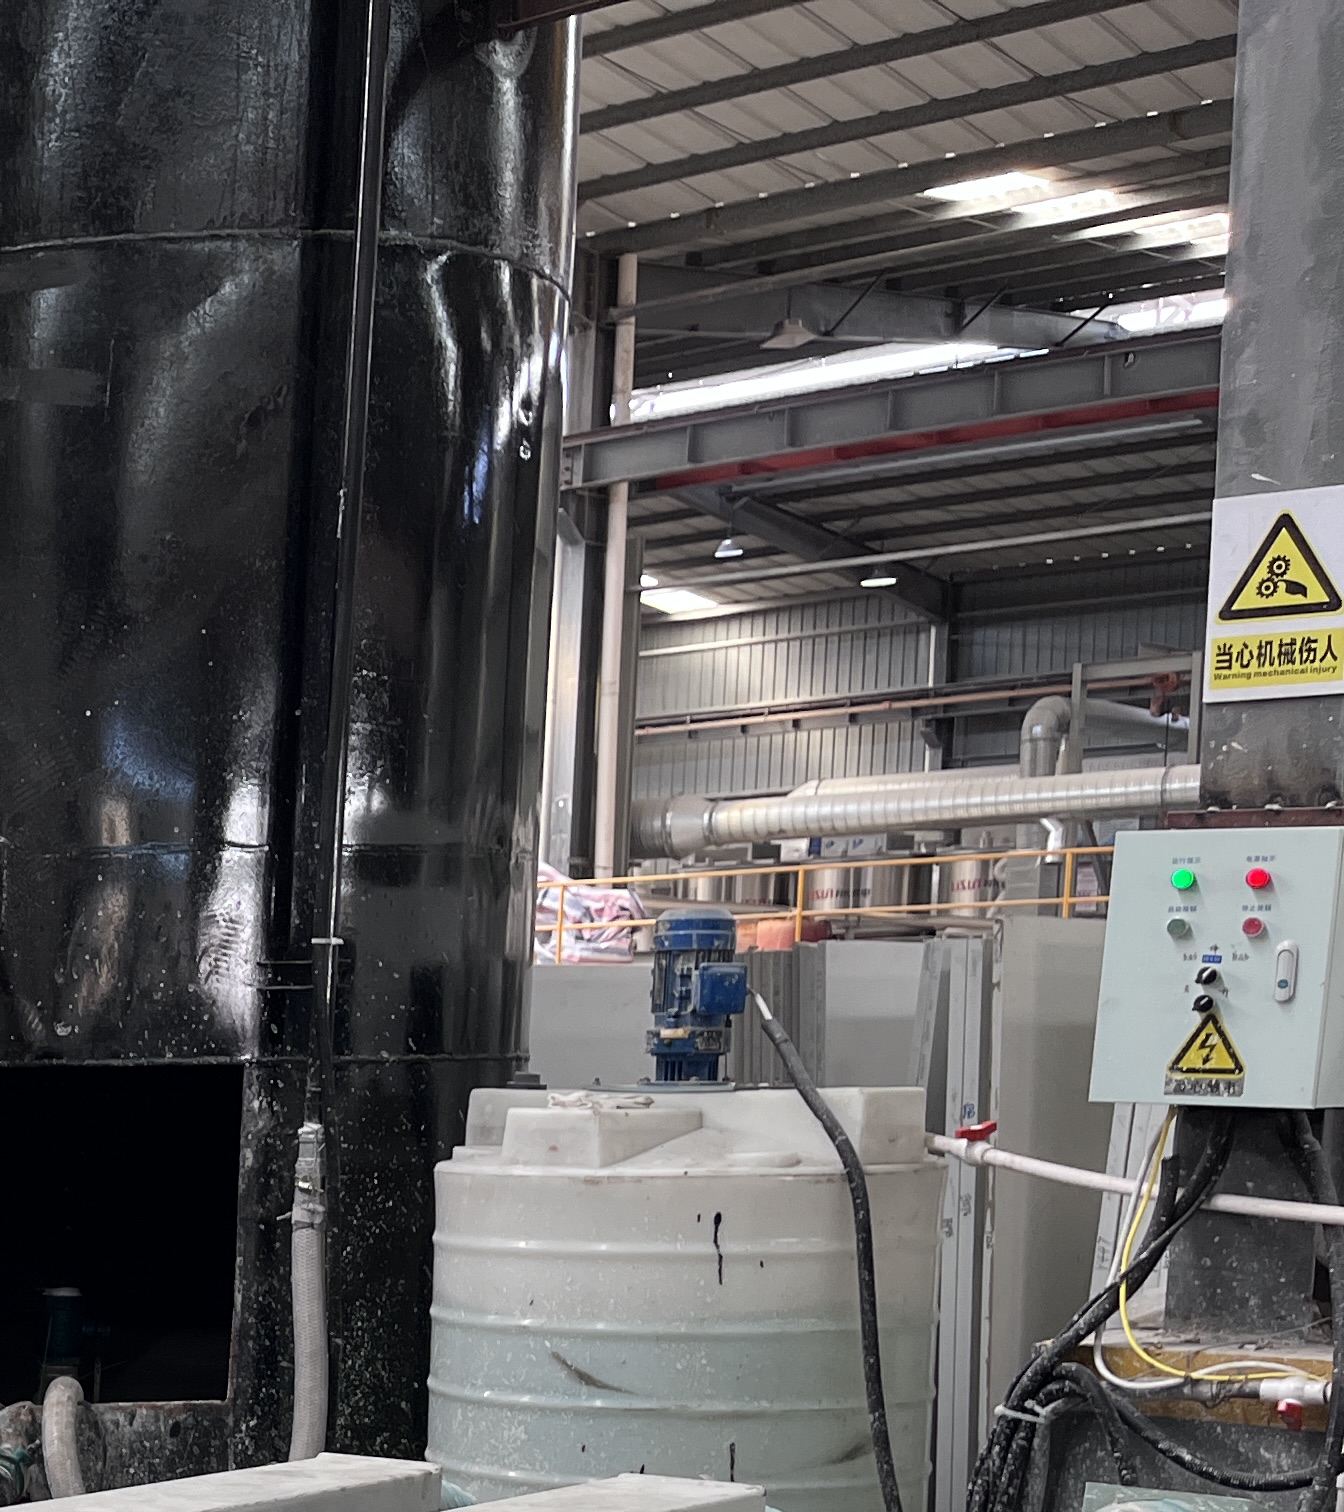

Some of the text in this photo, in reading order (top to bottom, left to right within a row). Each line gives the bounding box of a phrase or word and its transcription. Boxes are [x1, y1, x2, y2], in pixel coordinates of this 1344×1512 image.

[1215, 634, 1338, 670] 当心机械伤人
[1214, 665, 1337, 680] Warning mechanical injury
